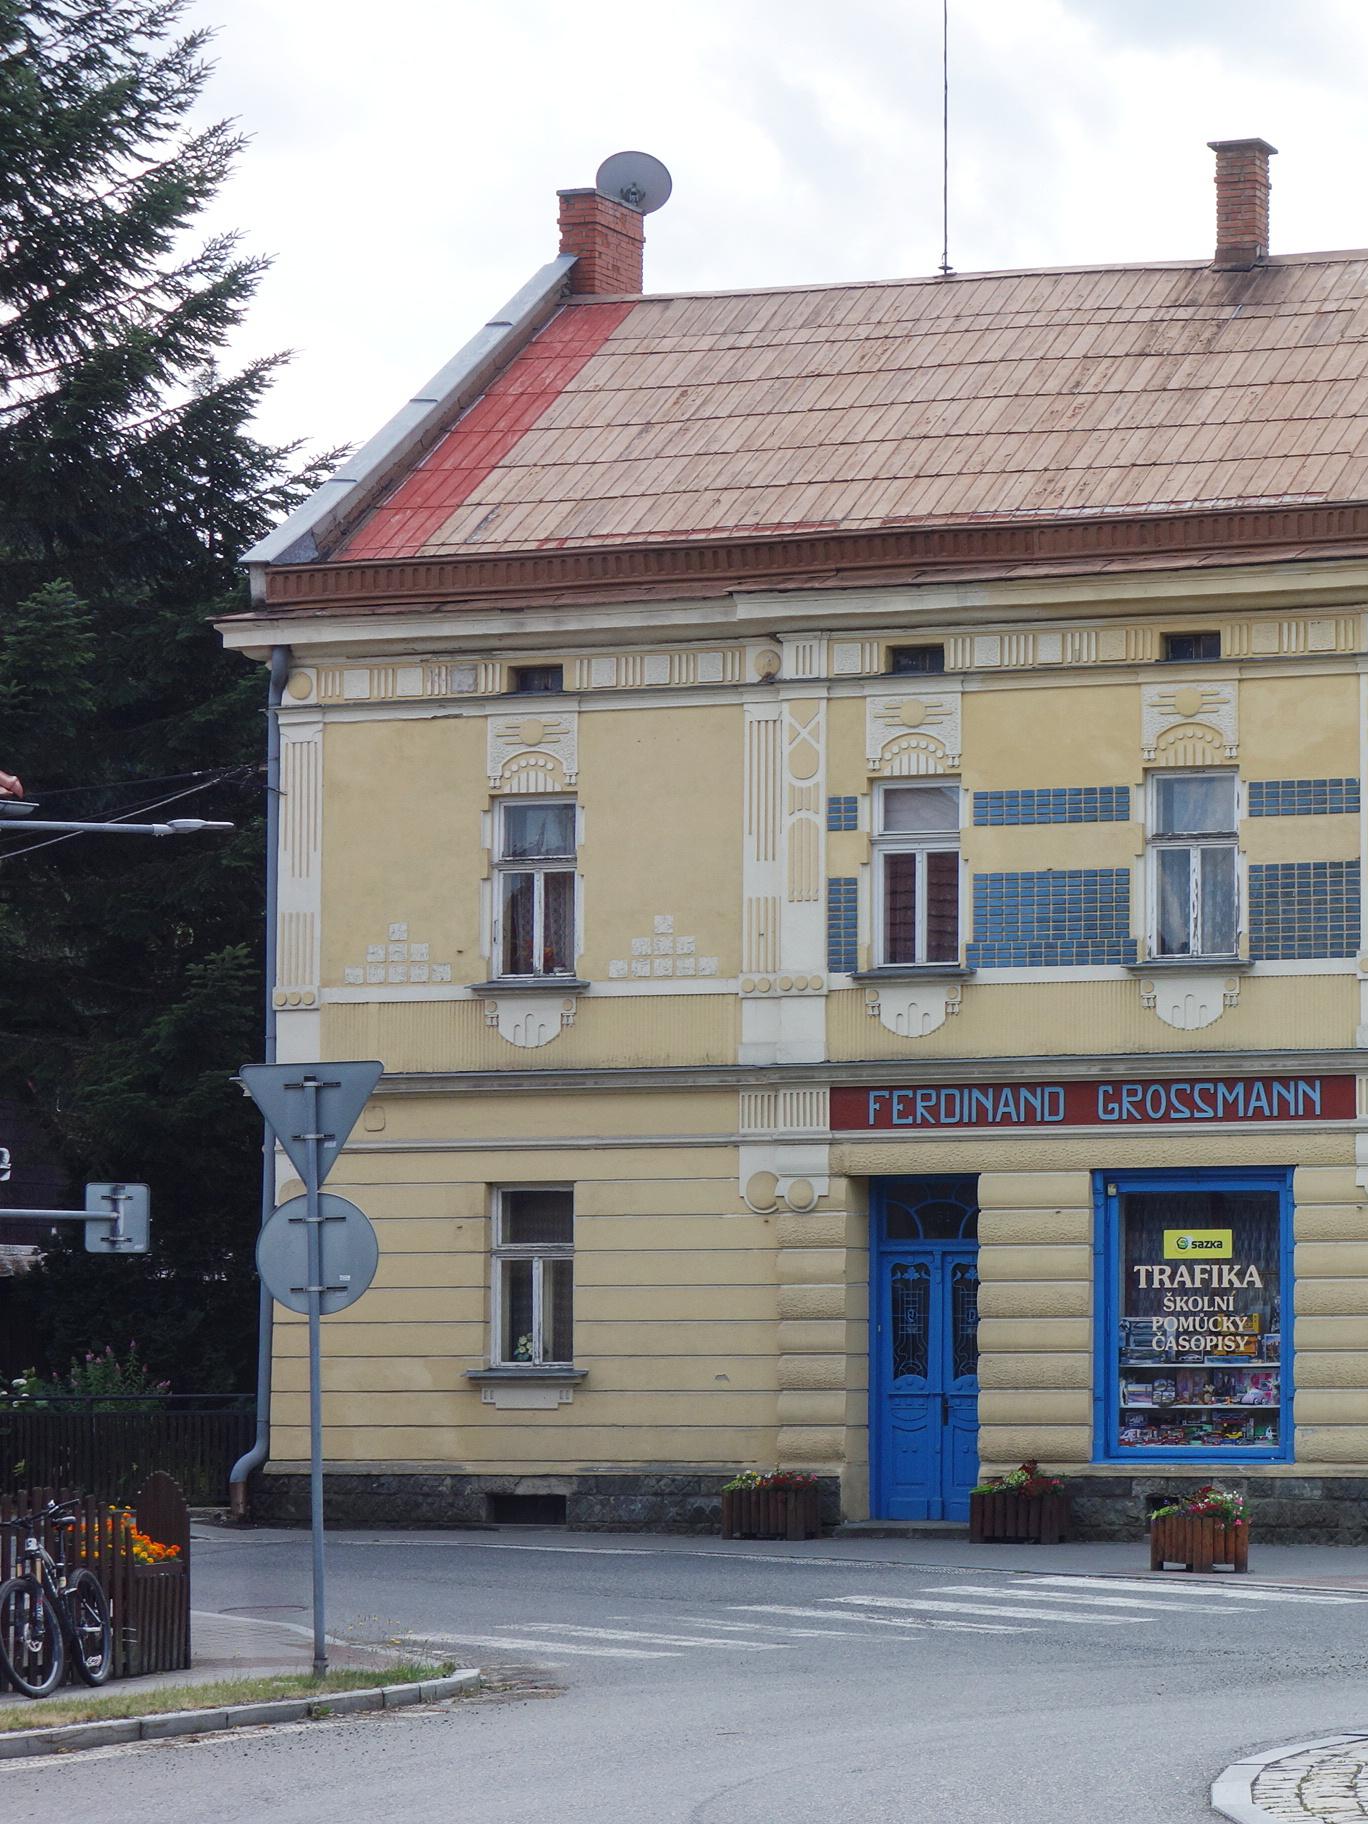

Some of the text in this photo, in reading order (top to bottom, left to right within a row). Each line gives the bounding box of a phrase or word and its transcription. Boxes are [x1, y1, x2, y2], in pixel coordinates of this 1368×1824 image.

[868, 1080, 1321, 1125] FERDINAND GROSSMANN
[1191, 1240, 1223, 1249] sazka
[1133, 1265, 1263, 1288] TRAFIKA
[1163, 1291, 1237, 1311] ŠKOLNÍ
[1152, 1313, 1248, 1332] POMŮCKY
[1152, 1332, 1249, 1351] ČASOPISY
